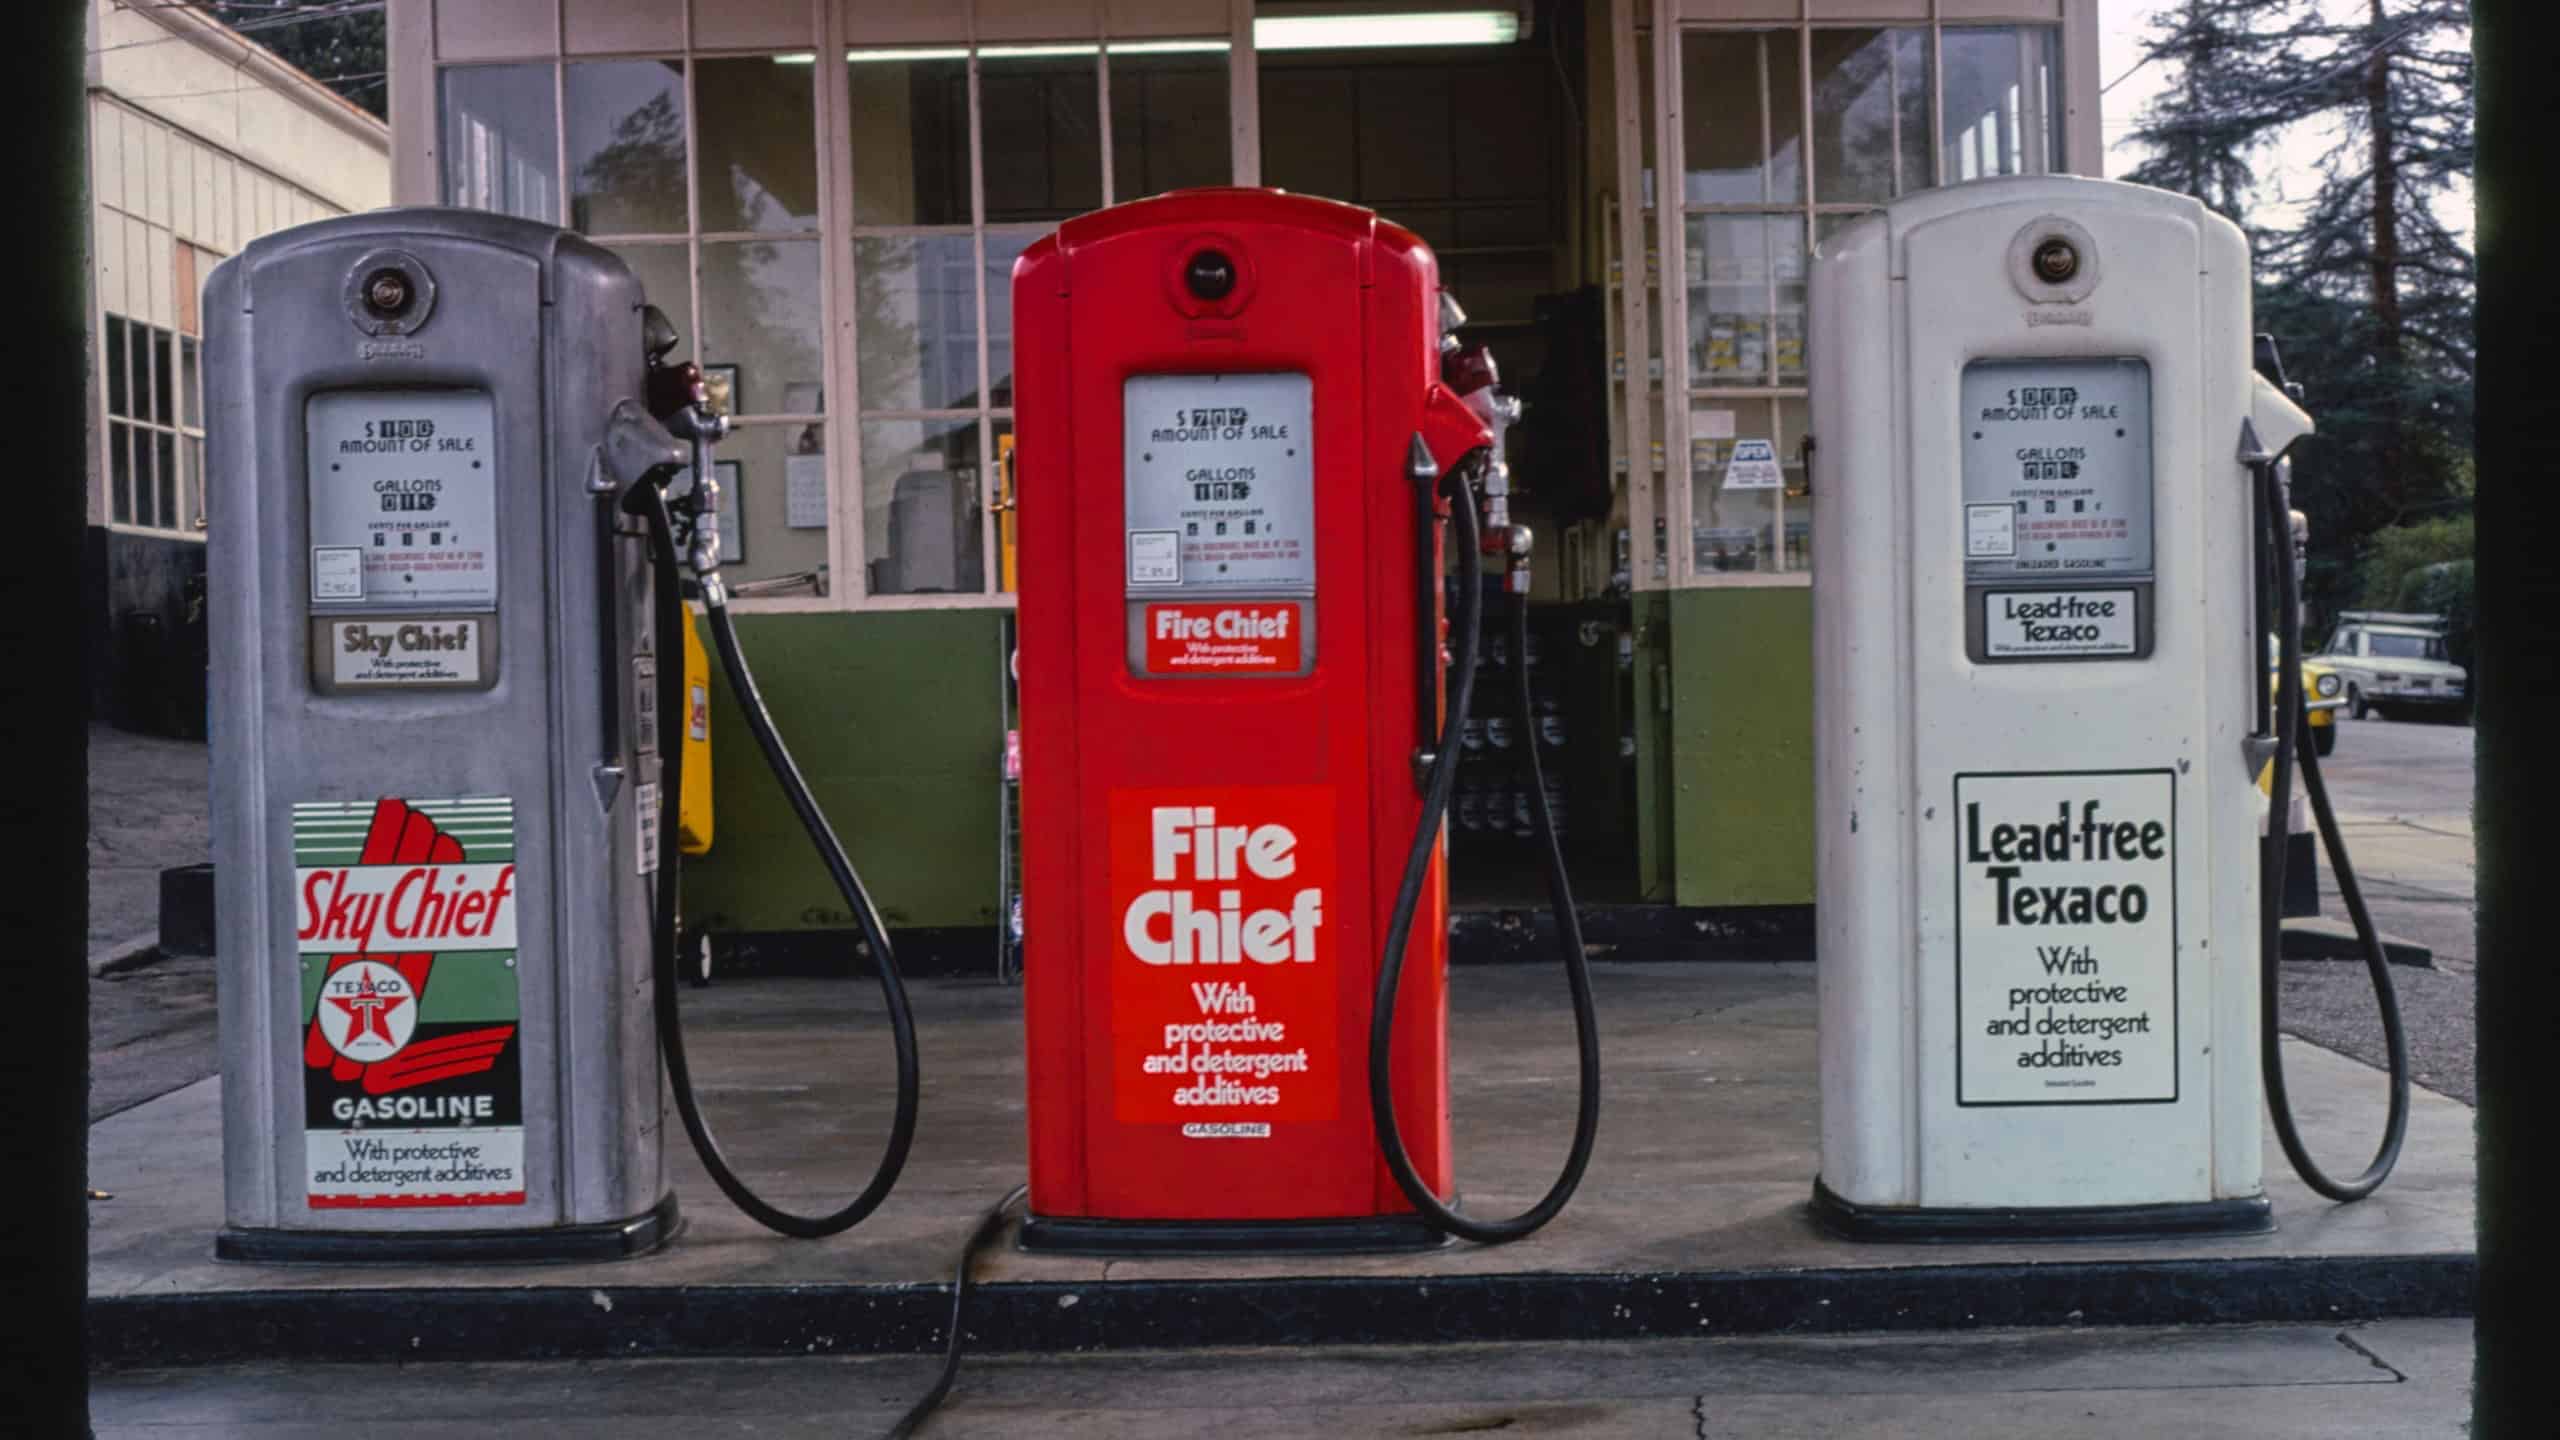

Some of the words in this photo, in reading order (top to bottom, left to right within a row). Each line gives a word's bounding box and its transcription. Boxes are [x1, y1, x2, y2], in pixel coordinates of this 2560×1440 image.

[1981, 407, 2049, 421] AMOUNT
[2053, 406, 2075, 420] OF
[2082, 405, 2119, 419] SALE
[340, 439, 405, 453] AMOUNT
[410, 438, 432, 452] OF
[438, 438, 475, 451] SALE
[1152, 427, 1218, 442] AMOUNT
[1222, 426, 1245, 440] OF
[1251, 425, 1288, 440] SALE
[2016, 447, 2086, 461] GALLONS
[373, 479, 443, 492] GALLONS
[1186, 468, 1256, 482] GALLONS
[2005, 596, 2115, 620] Lead-free
[1156, 610, 1211, 639] Fire
[1215, 610, 1289, 639] Chief
[2021, 620, 2100, 642] Texaco
[343, 624, 394, 658] Sky
[397, 624, 469, 651] Chief
[370, 657, 392, 667] With
[1152, 806, 1297, 881] Fire
[1966, 800, 2165, 863] Lead-free
[297, 868, 384, 954] Sky
[385, 864, 515, 940] Chief
[1985, 866, 2148, 926] Texaco
[1124, 888, 1322, 965] Chief
[2036, 945, 2098, 976] With
[332, 979, 402, 994] TEXACO
[1191, 981, 1256, 1015] With
[2009, 980, 2128, 1011] protective
[1164, 1016, 1285, 1048] protective
[1986, 1006, 2031, 1036] and
[2035, 1006, 2150, 1040] detergent
[1143, 1043, 1188, 1074] and
[1191, 1043, 1309, 1079] detergent
[2016, 1038, 2123, 1068] additives
[1173, 1074, 1280, 1106] additives
[333, 1096, 494, 1121] GASOLINE
[1185, 1123, 1267, 1136] GASOLINE
[345, 1138, 390, 1161] With
[393, 1139, 481, 1165] protective
[314, 1162, 348, 1184] and
[350, 1162, 433, 1187] detergent
[435, 1161, 513, 1183] additives
